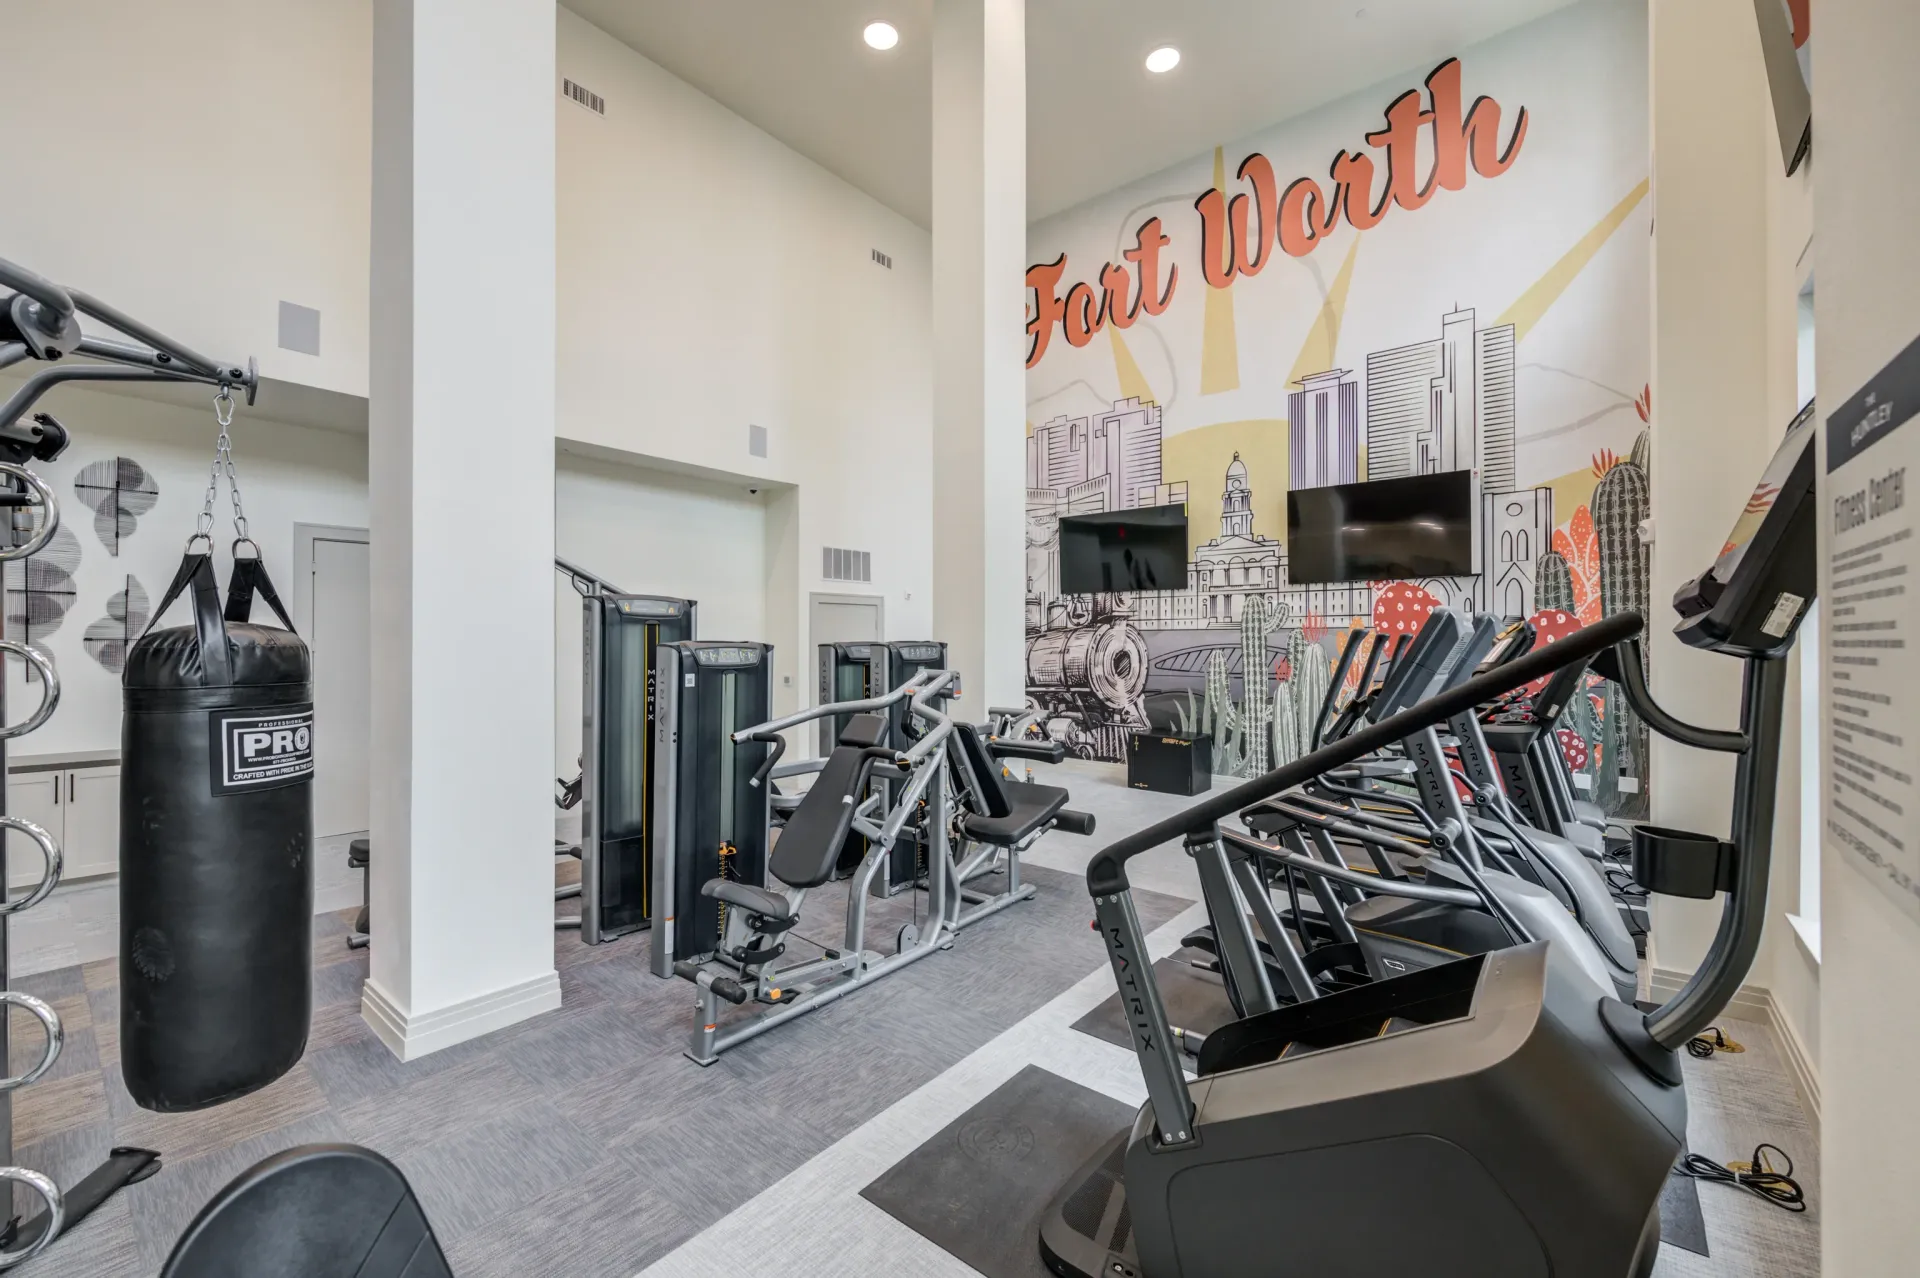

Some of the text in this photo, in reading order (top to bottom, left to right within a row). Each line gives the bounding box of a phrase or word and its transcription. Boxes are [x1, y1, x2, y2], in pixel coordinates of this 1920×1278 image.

[1026, 57, 1529, 370] Fort Worth
[1834, 467, 1907, 536] Fitness Center
[647, 668, 656, 721] MATRIX
[233, 772, 265, 780] CRAFTED
[266, 768, 280, 776] WITH
[281, 766, 294, 774] PRIDE
[244, 727, 309, 757] PRO
[1460, 722, 1484, 777] MATRIX
[1415, 743, 1446, 810] MATRIX
[1508, 764, 1538, 828] MAT
[1110, 927, 1155, 1051] MATRIX
